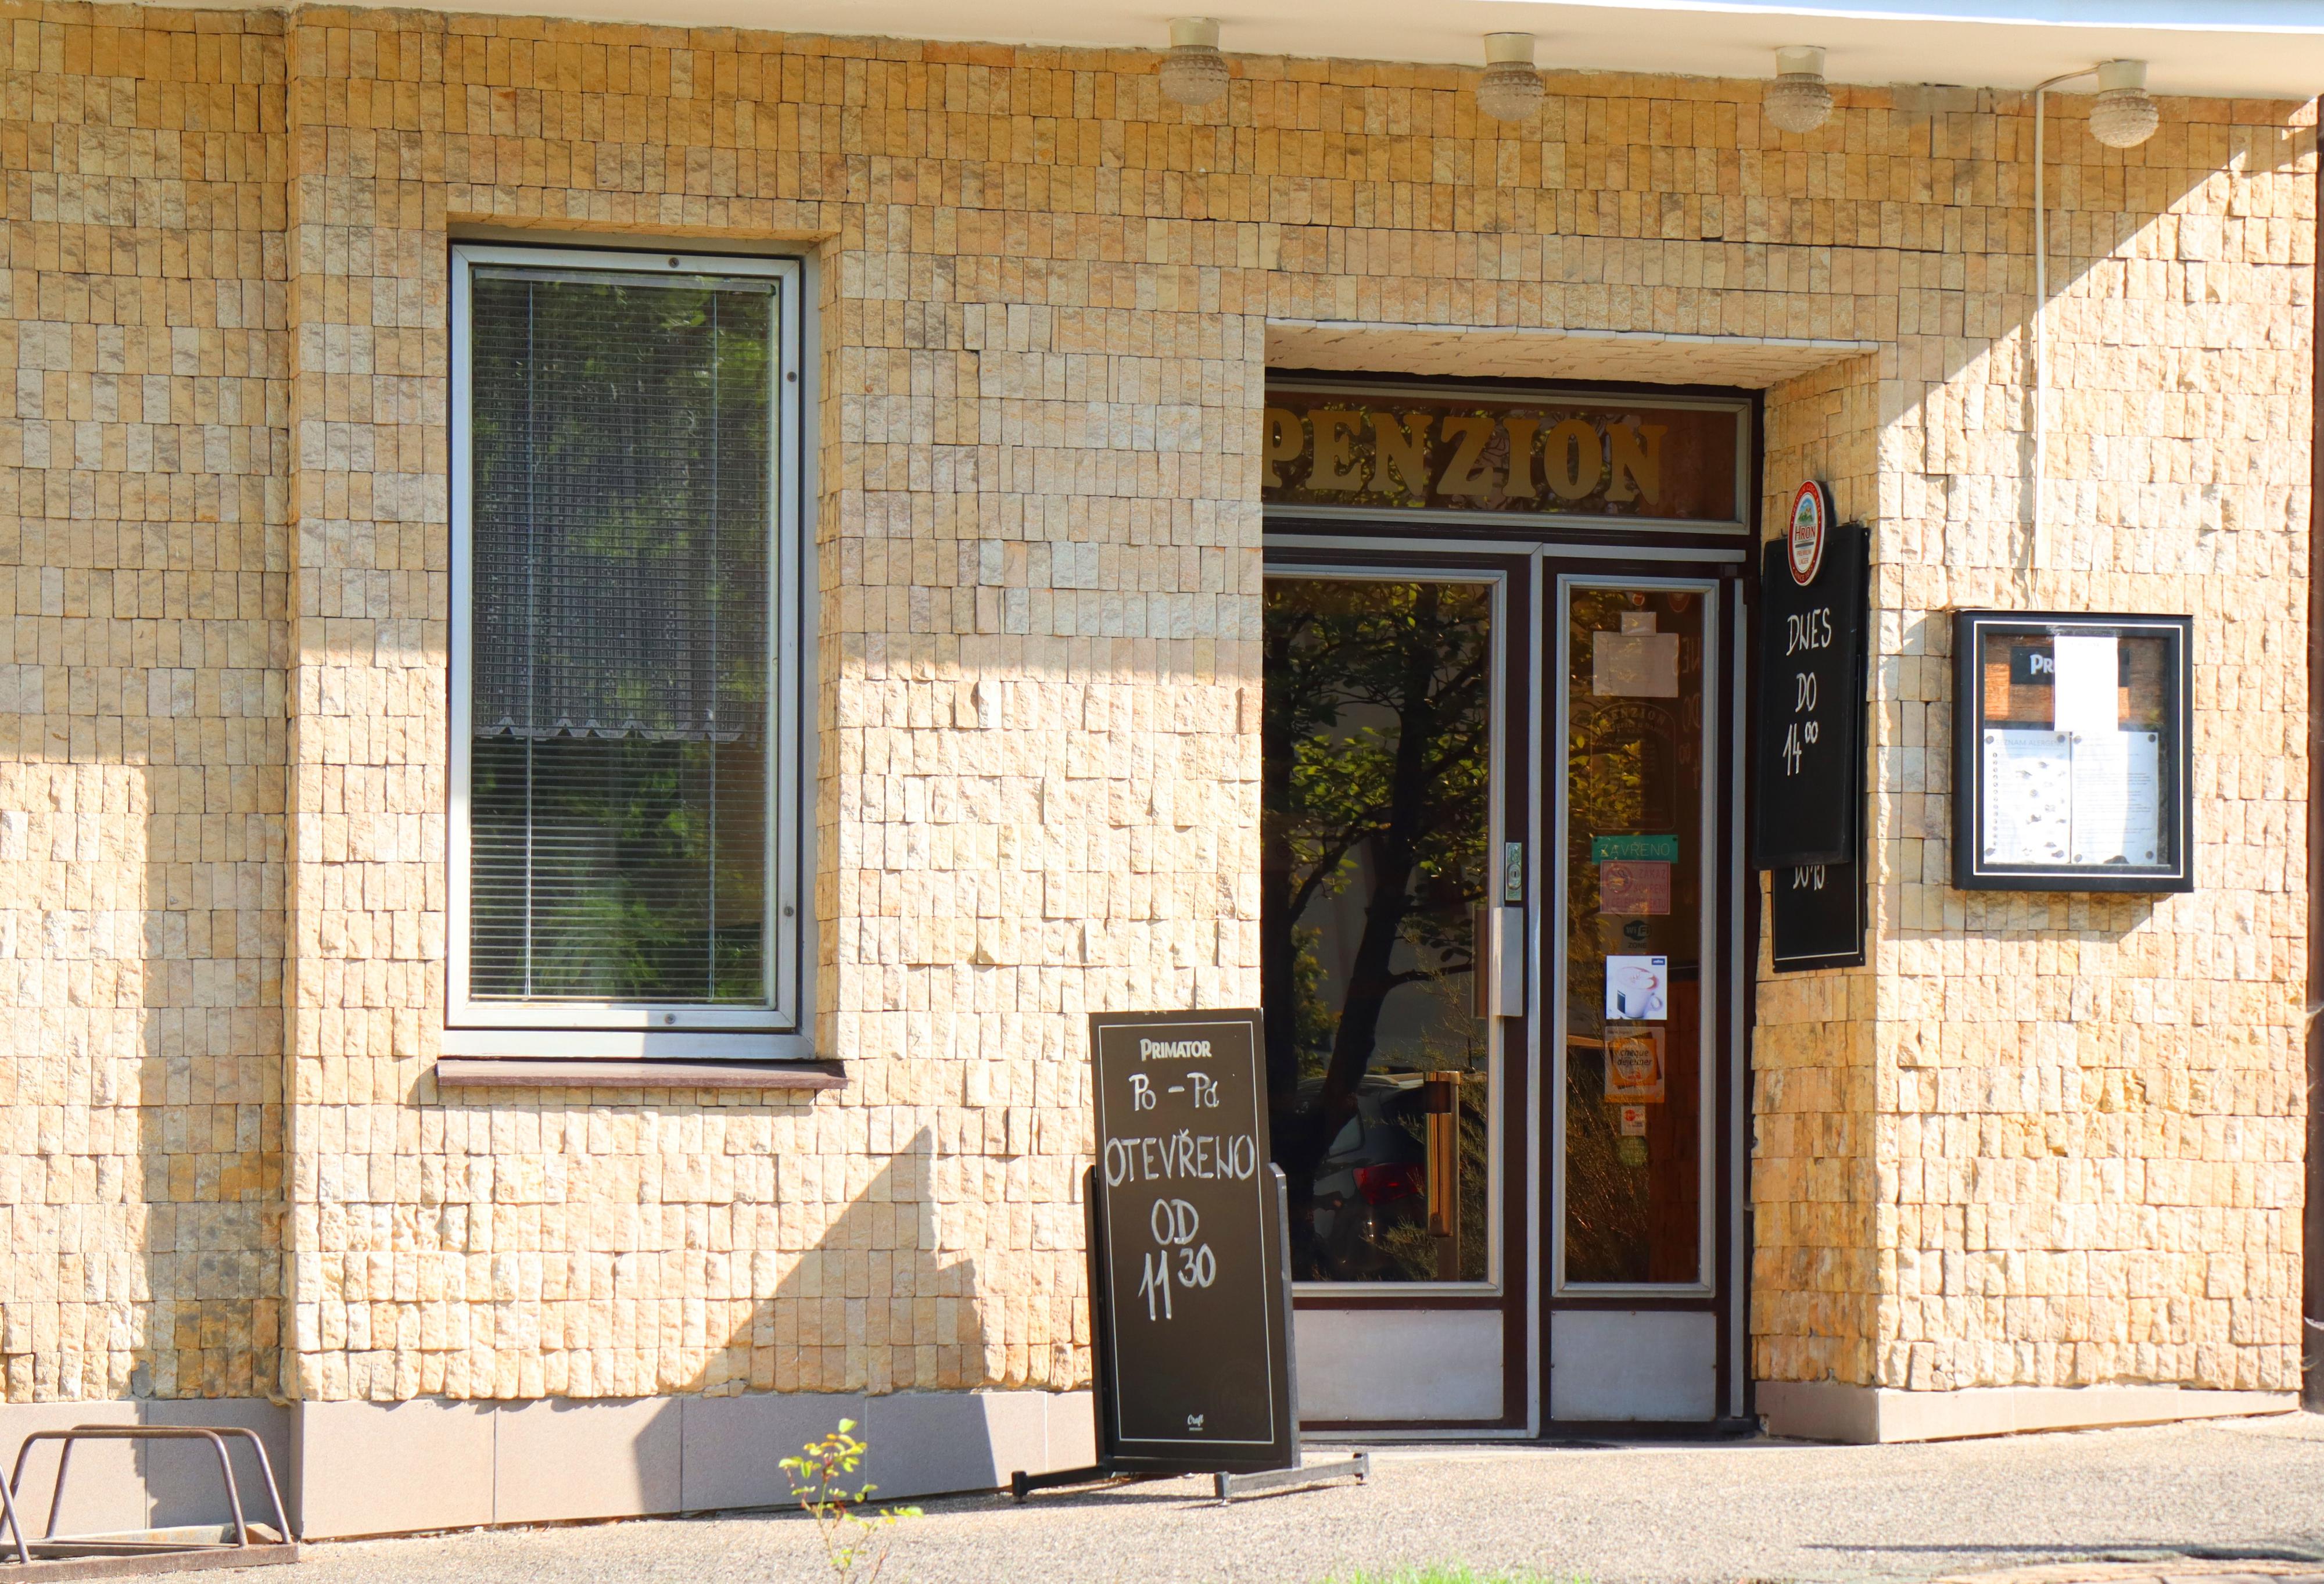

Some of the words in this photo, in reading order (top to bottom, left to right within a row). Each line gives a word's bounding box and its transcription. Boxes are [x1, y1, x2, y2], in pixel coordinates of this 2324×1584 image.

[1263, 407, 1669, 506] PENZION
[1795, 524, 1816, 541] HRON
[1786, 607, 1832, 656] DNES
[1795, 671, 1817, 714] DO
[1599, 842, 1670, 857] ZAVŘENO
[1140, 1038, 1212, 1062] PRIMATOR
[1128, 1073, 1156, 1111] Po
[1106, 1128, 1255, 1187] OTEVŘENO
[1151, 1198, 1199, 1245] OD
